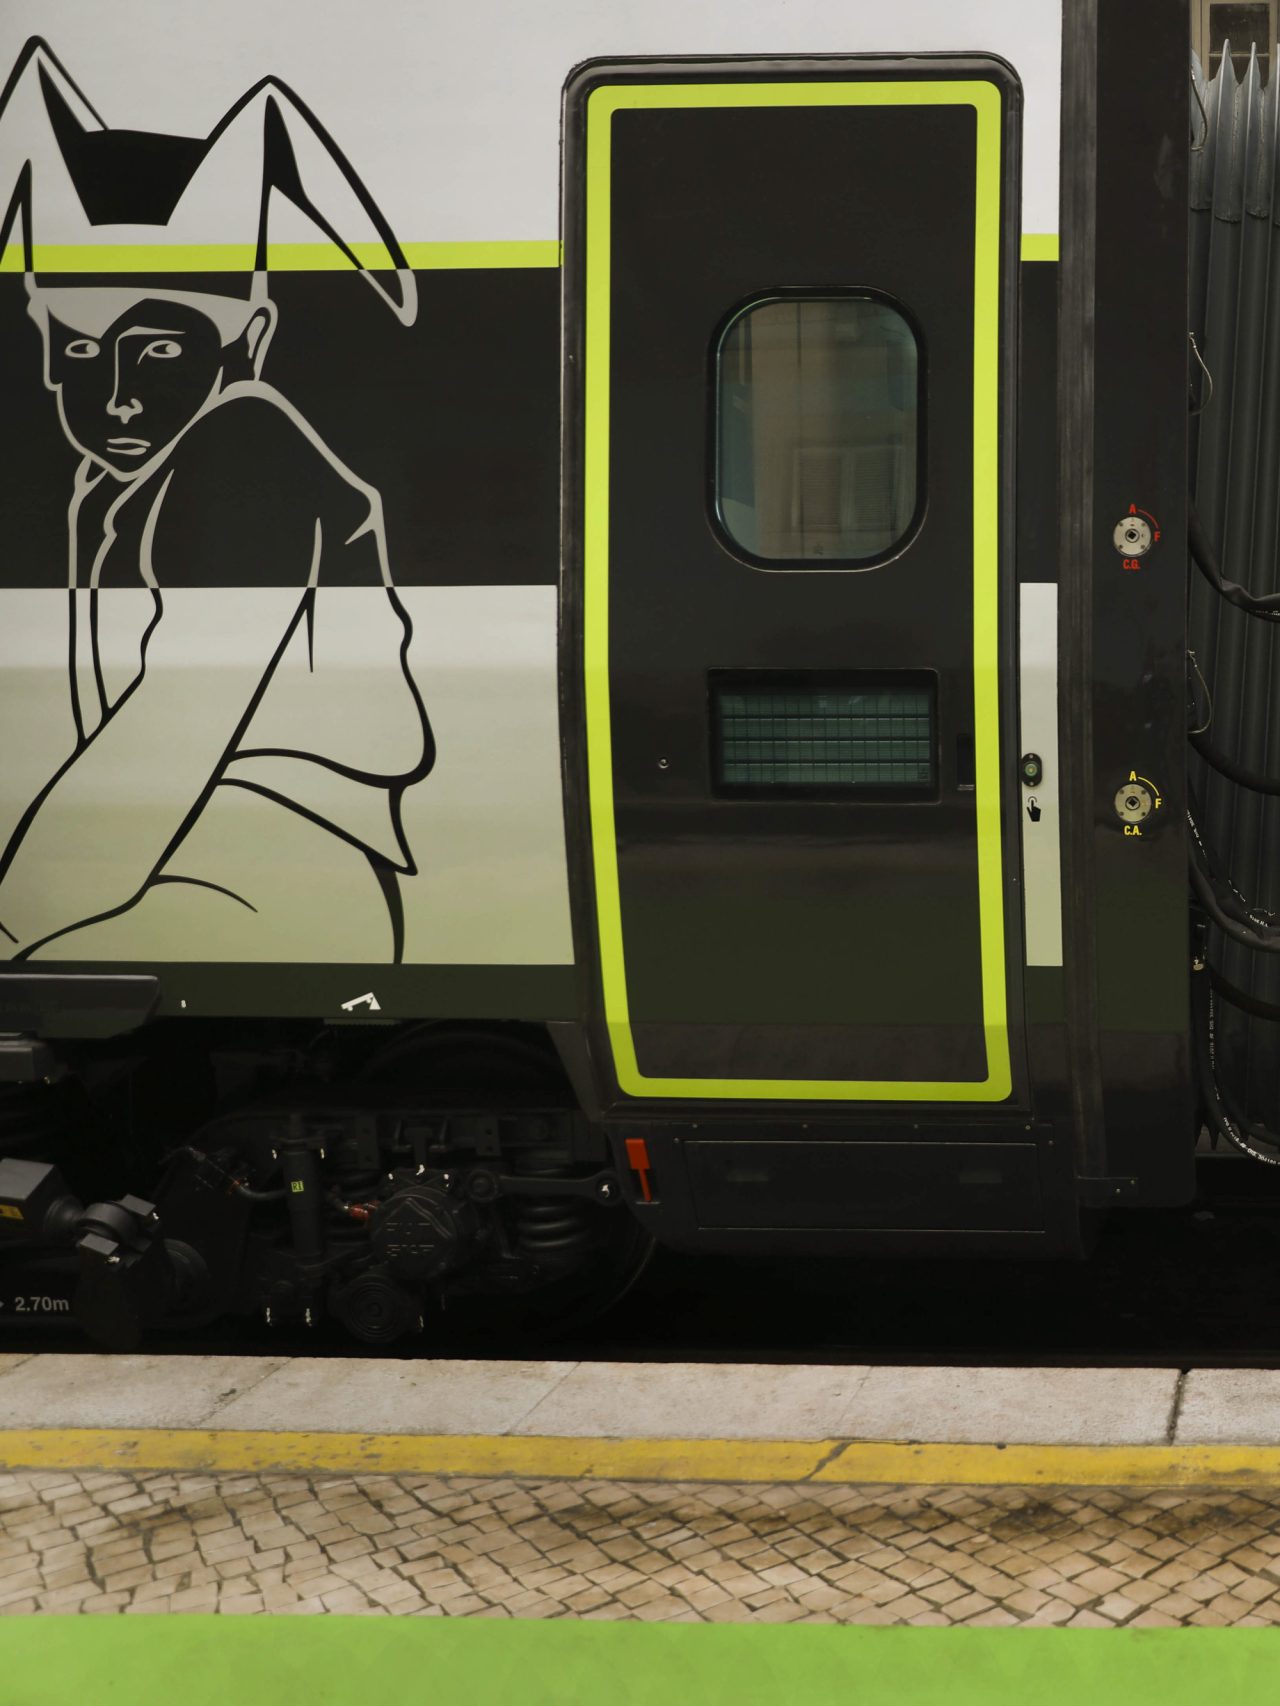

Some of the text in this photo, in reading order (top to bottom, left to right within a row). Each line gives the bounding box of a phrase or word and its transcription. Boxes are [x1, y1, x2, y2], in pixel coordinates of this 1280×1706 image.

[1129, 503, 1136, 514] A
[1153, 530, 1161, 542] F
[1129, 770, 1137, 781] A
[1155, 798, 1162, 809] F
[1124, 825, 1143, 836] C.A.
[15, 1296, 70, 1311] 2.70m
